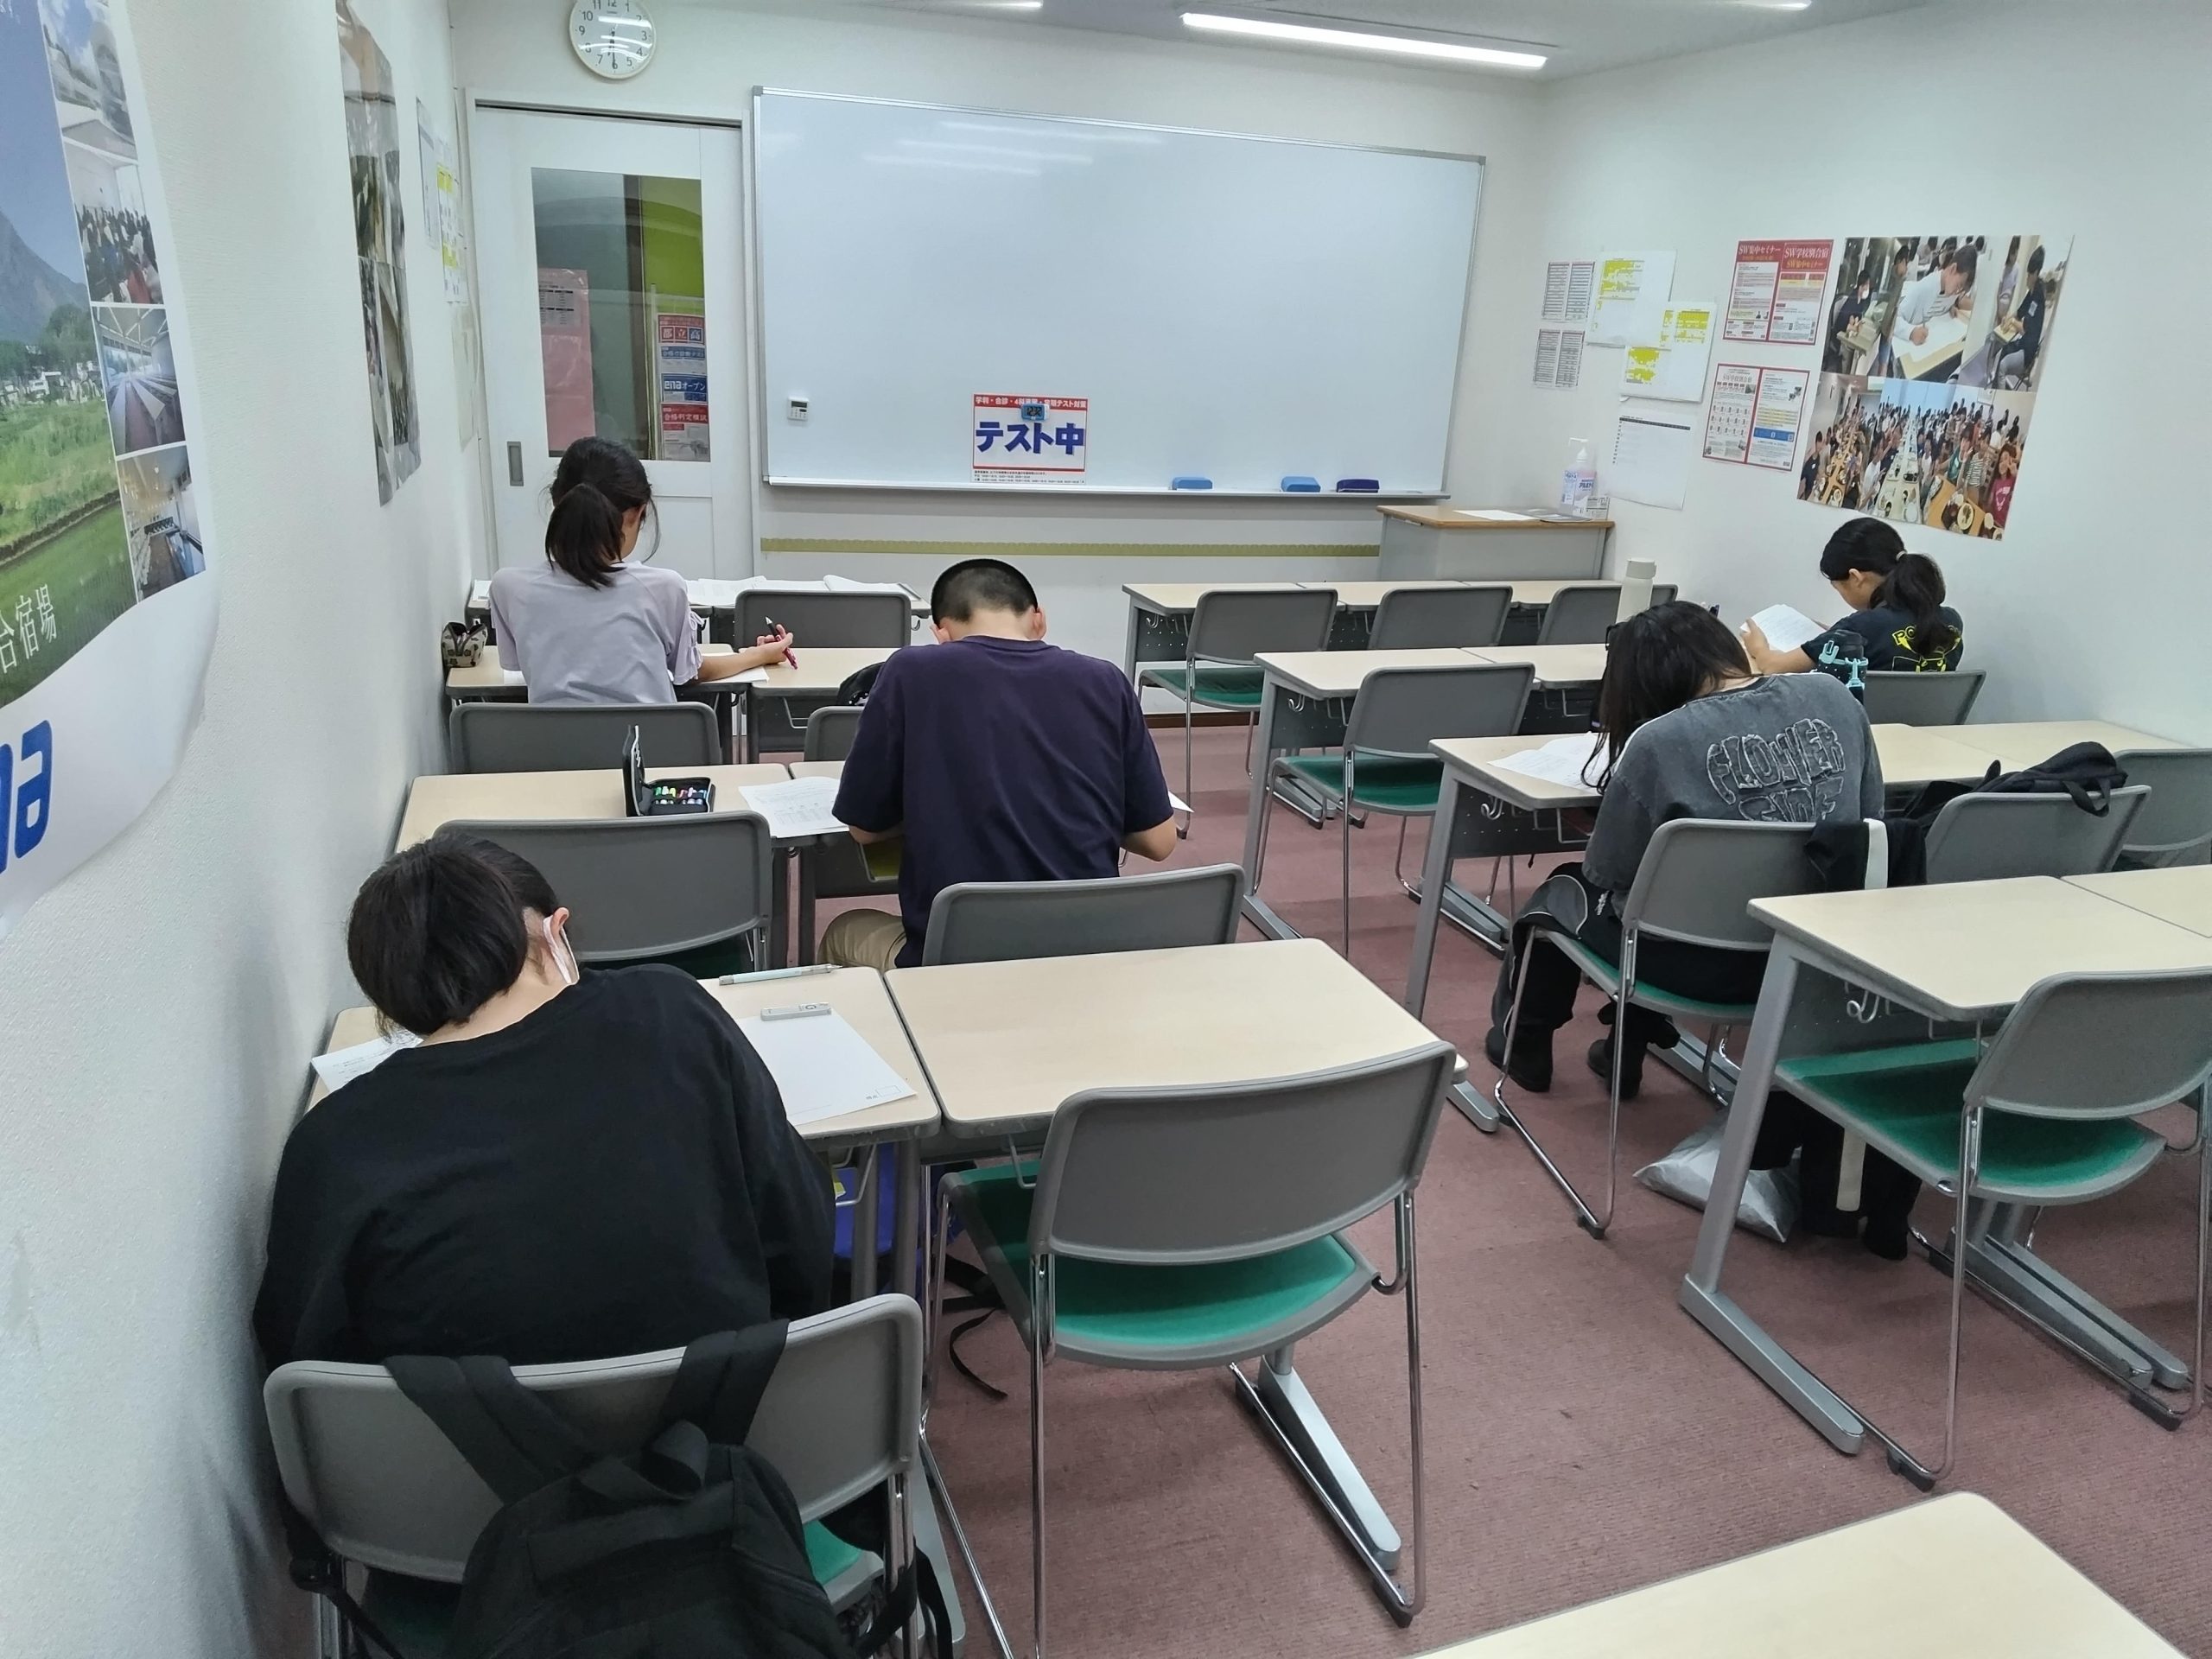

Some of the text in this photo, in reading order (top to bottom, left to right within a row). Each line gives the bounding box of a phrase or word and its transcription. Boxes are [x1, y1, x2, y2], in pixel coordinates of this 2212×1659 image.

[593, 0, 601, 10] 11
[582, 10, 594, 21] 10
[578, 25, 586, 35] 9
[641, 30, 647, 41] 3
[636, 47, 643, 56] 4
[597, 54, 603, 65] 7
[612, 60, 619, 70] 6
[626, 56, 632, 67] 5
[976, 422, 1085, 455] テスト中
